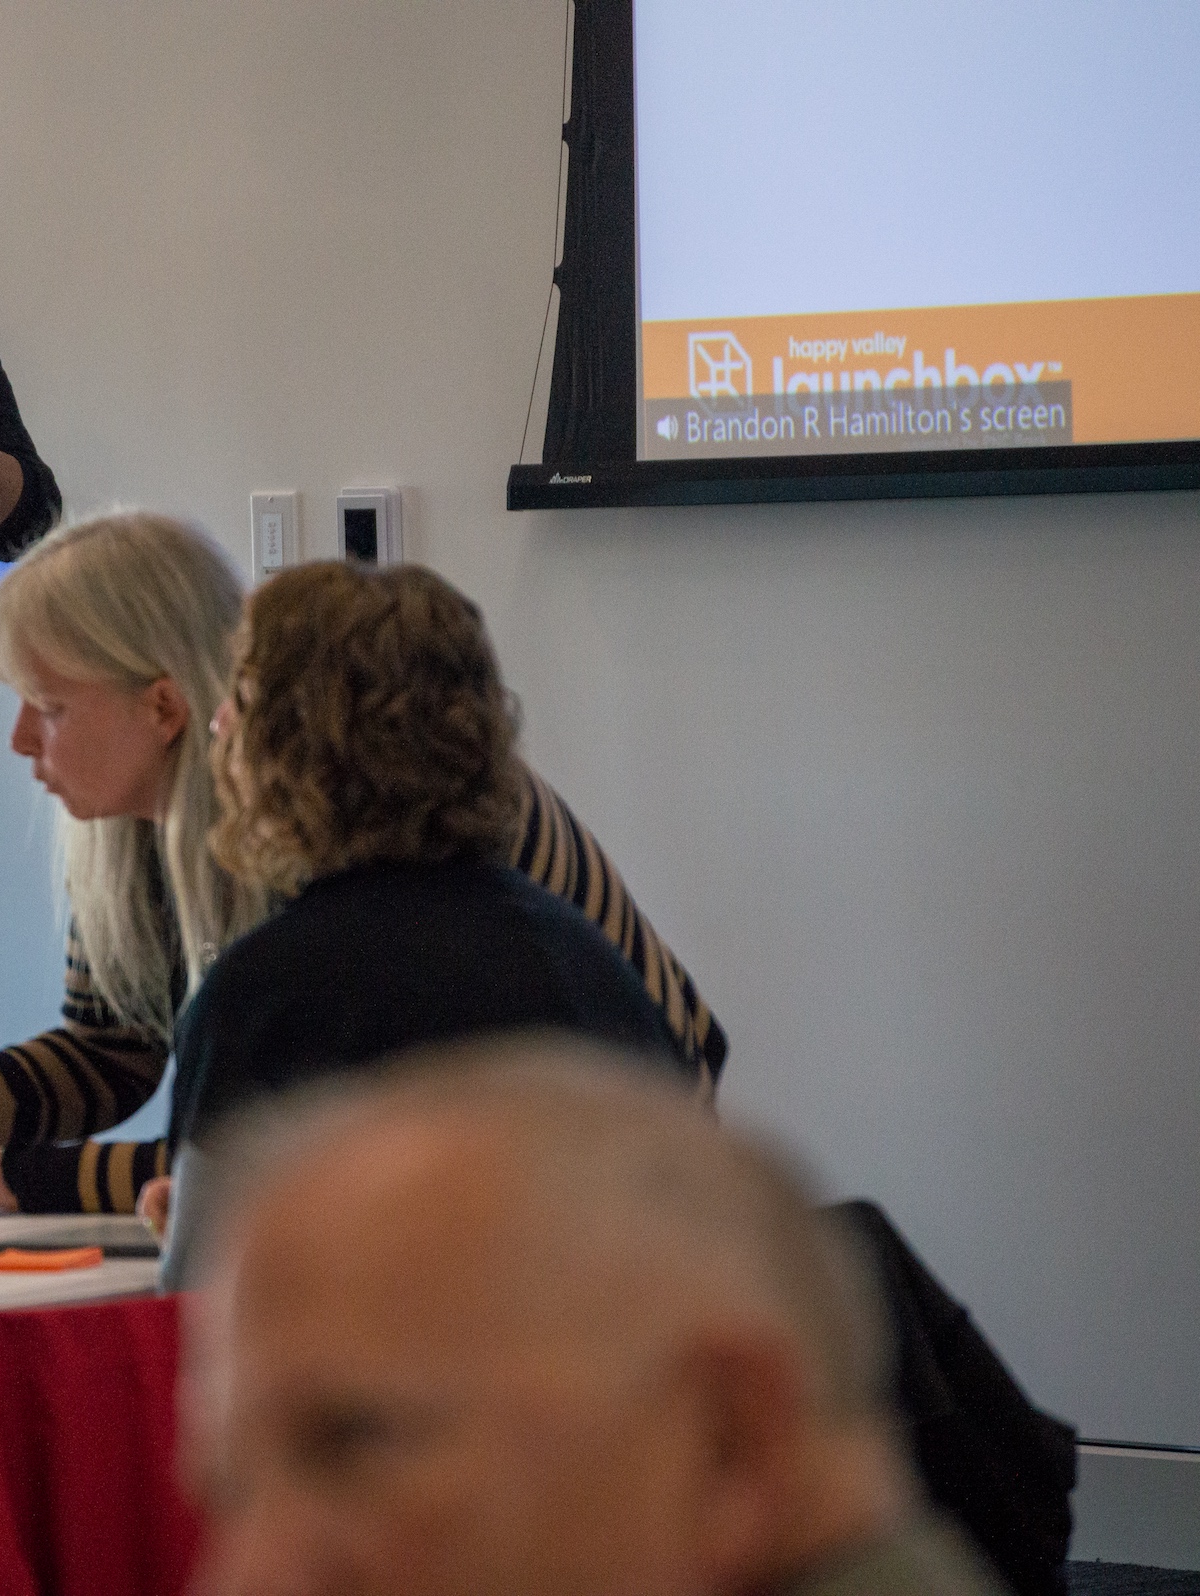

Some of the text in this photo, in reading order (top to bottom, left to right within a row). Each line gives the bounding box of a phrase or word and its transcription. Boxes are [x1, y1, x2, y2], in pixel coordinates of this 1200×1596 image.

[789, 331, 907, 362] happy valley
[687, 402, 1066, 443] Brandon R Hamilton's screen
